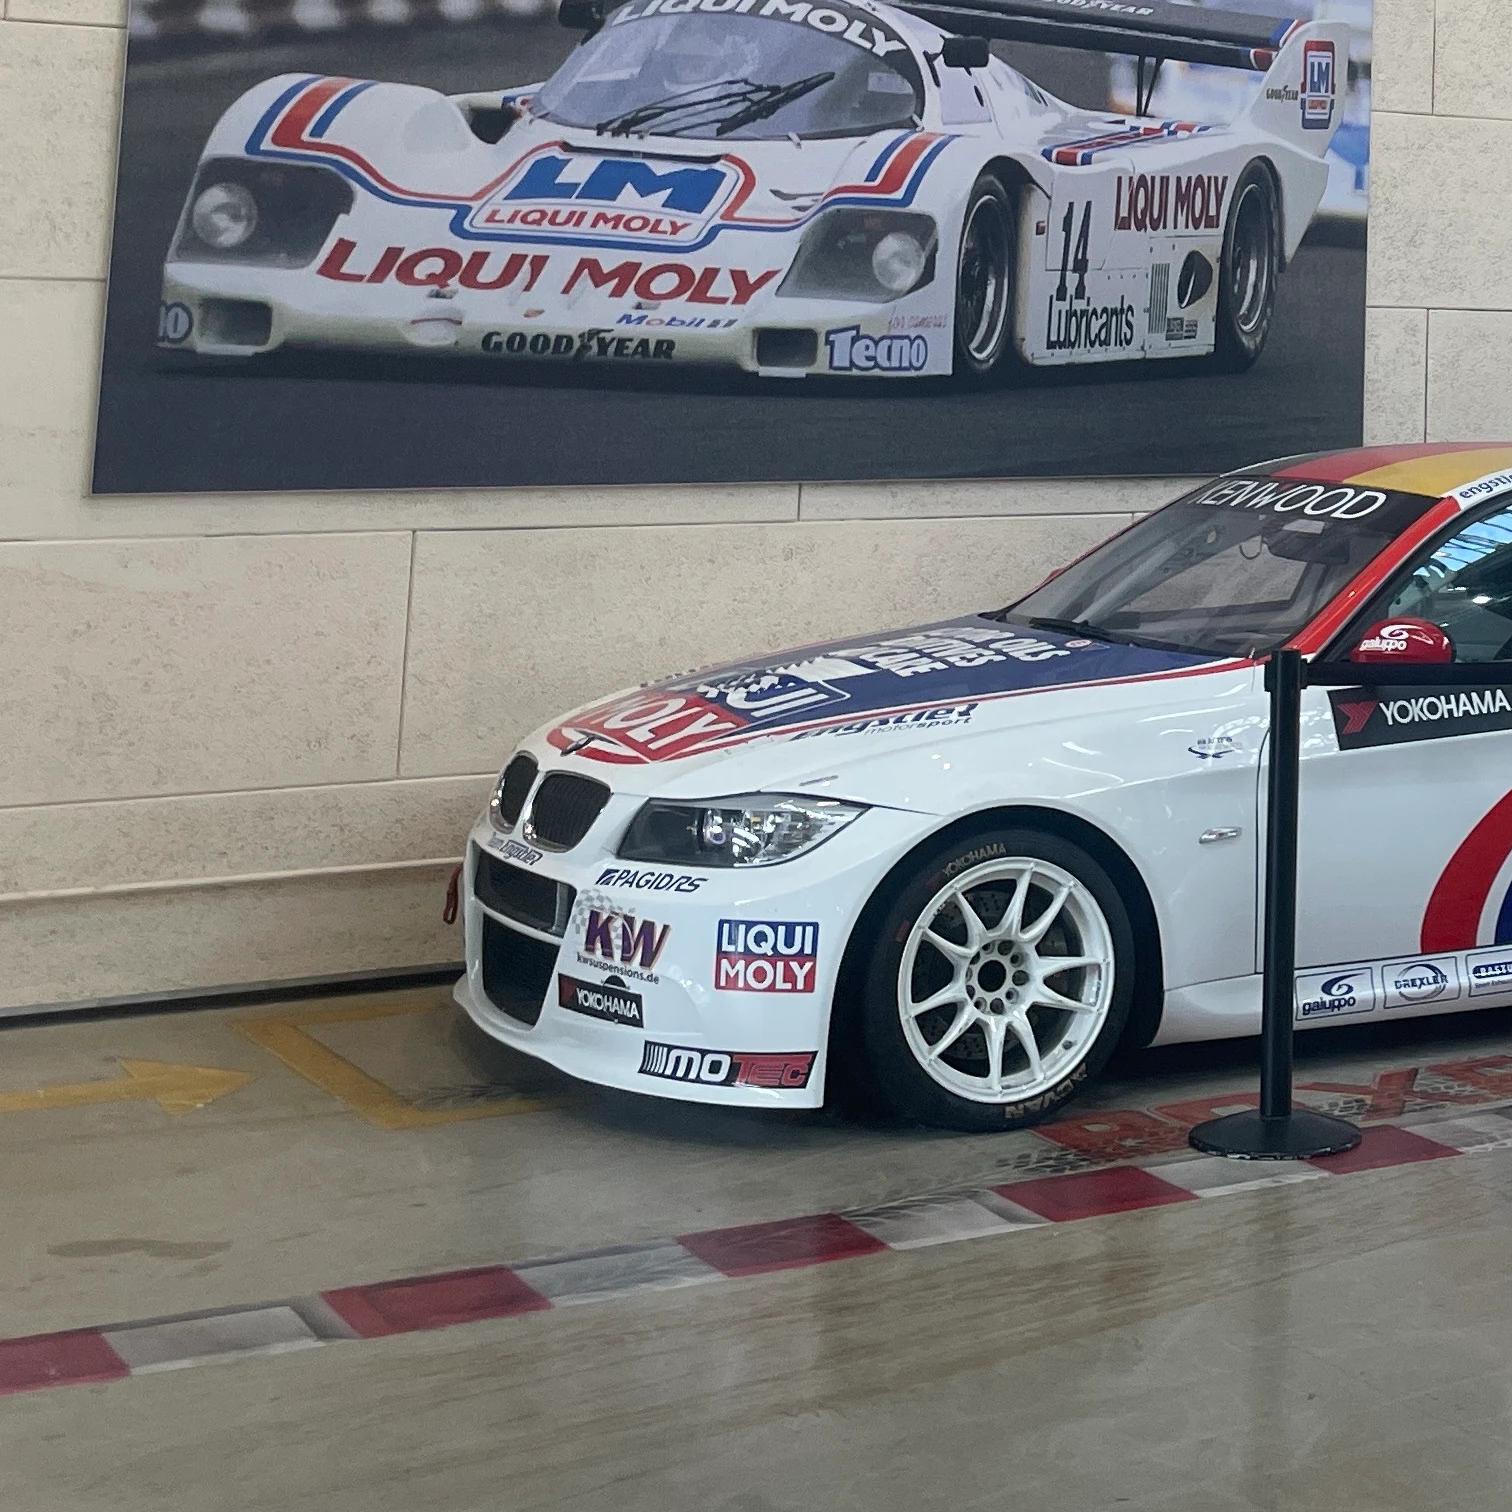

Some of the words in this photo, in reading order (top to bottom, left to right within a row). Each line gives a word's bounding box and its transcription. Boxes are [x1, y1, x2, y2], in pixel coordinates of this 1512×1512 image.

[503, 155, 727, 214] LM
[1114, 174, 1170, 232] LIQUI
[1173, 174, 1229, 231] MOLY
[484, 209, 588, 227] LIQUI
[591, 213, 693, 236] MOLY
[1056, 200, 1092, 301] 14
[317, 239, 549, 295] LIQUI
[562, 257, 782, 306] MOLY
[616, 314, 705, 328] Mobil
[1046, 294, 1135, 350] Lubricants
[481, 328, 676, 360] GOODYEAR
[825, 324, 928, 371] Tecno
[1379, 688, 1512, 725] YOKOHAMA
[864, 714, 972, 735] motorsport
[942, 843, 1007, 877] YOKOHAMA
[584, 908, 671, 970] KW
[721, 922, 815, 956] LIQUI
[577, 952, 660, 985] kwsuspensions.de
[719, 958, 815, 990] MOLY
[1394, 974, 1449, 990] DREXLER
[575, 987, 641, 1019] YOKOHAMA
[1302, 996, 1357, 1016] galuppo
